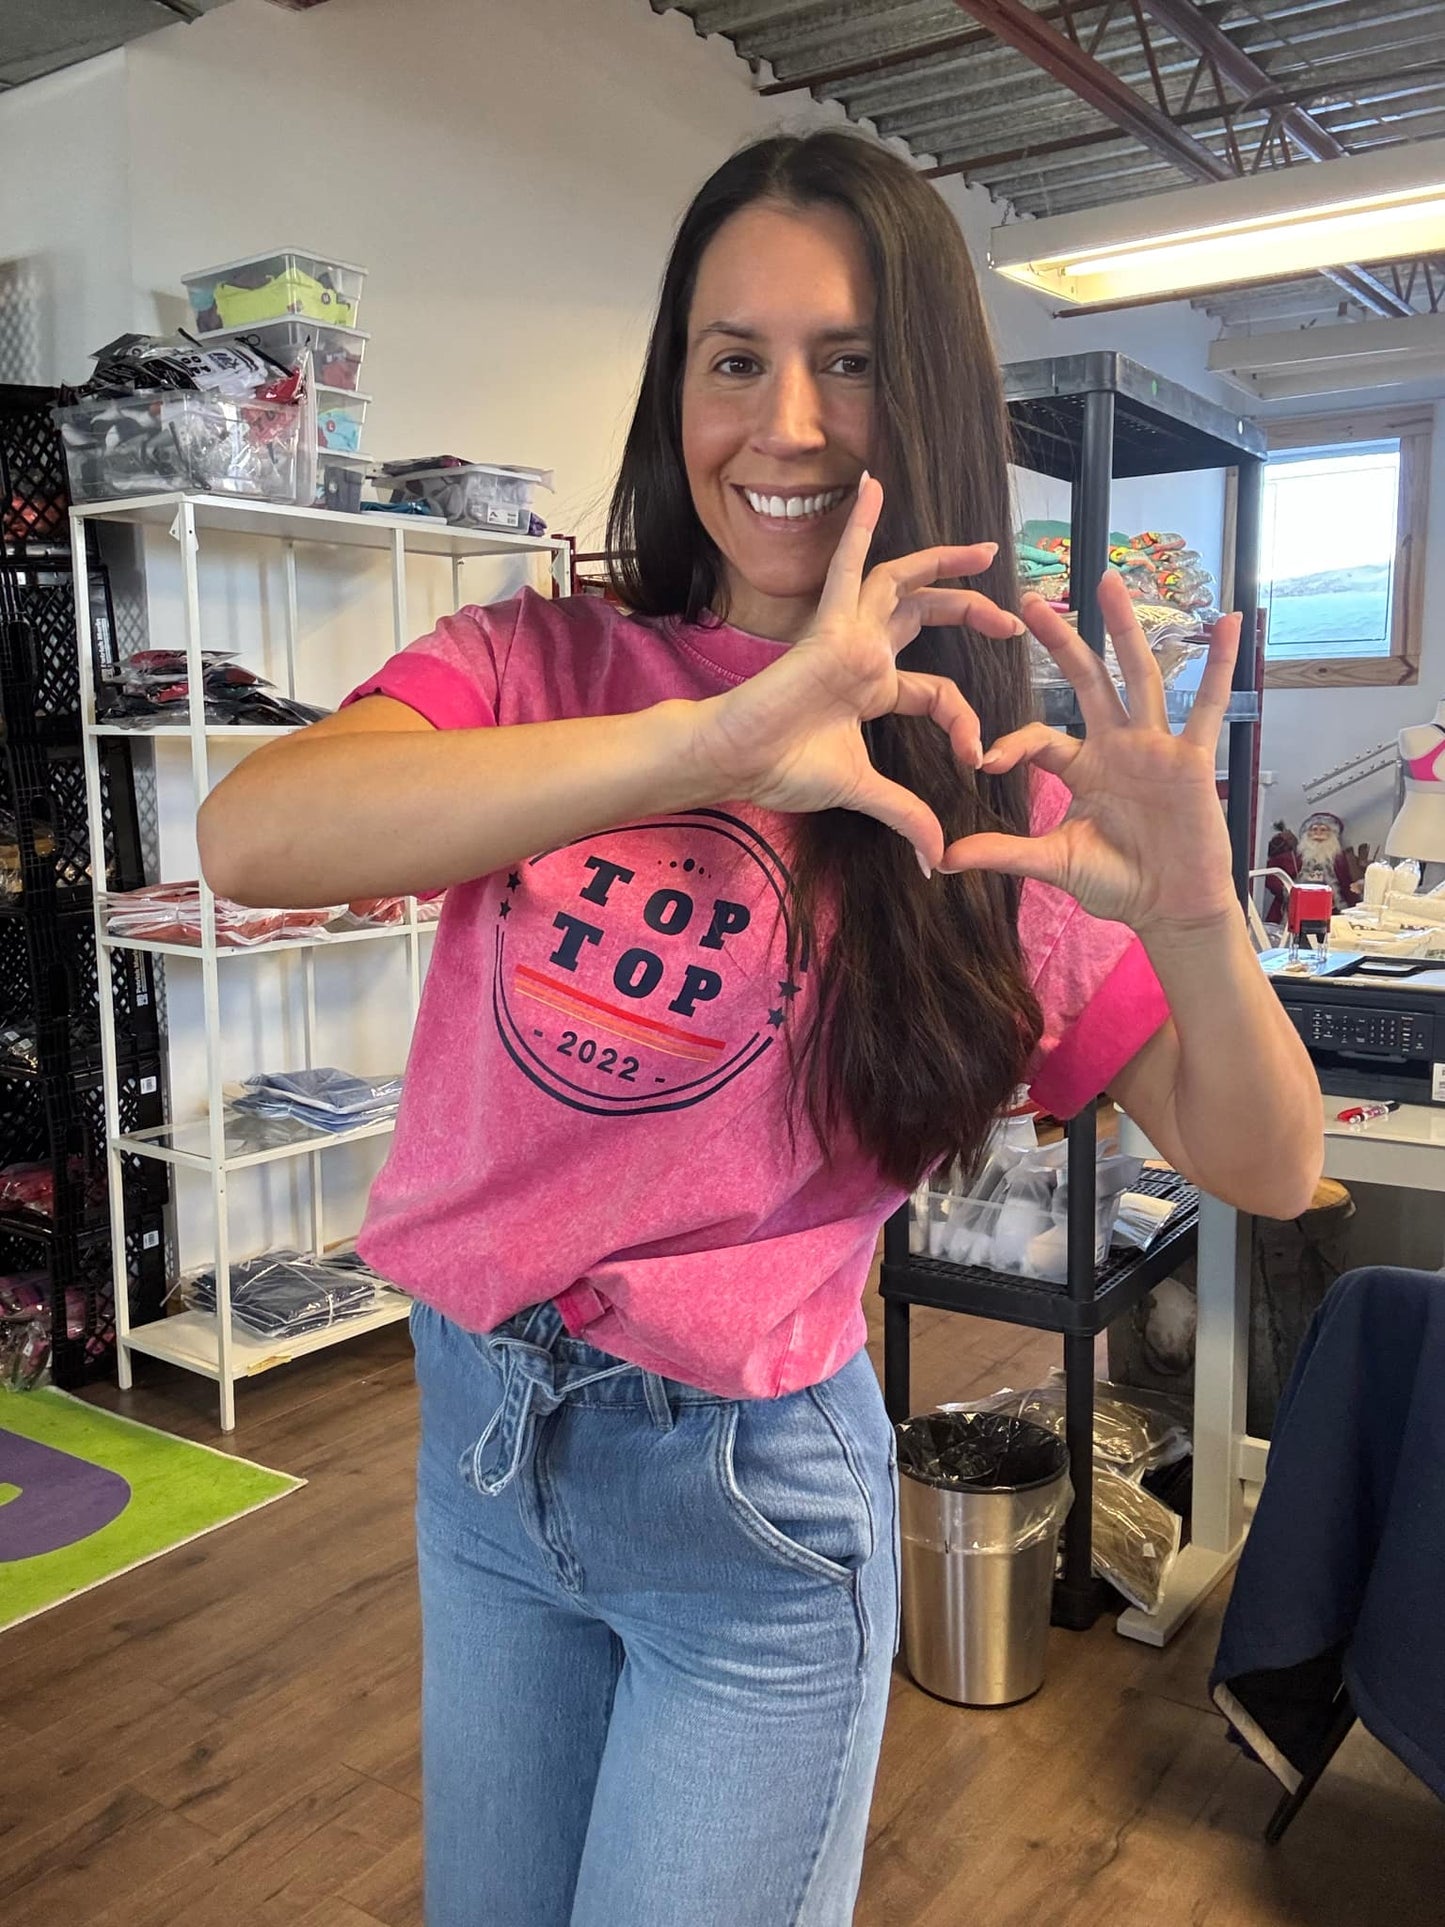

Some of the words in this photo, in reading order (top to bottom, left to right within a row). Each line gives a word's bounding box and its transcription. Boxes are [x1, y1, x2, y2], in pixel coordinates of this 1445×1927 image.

[579, 855, 751, 950] TOP
[549, 911, 723, 1018] TOP
[556, 1031, 640, 1082] 2022
